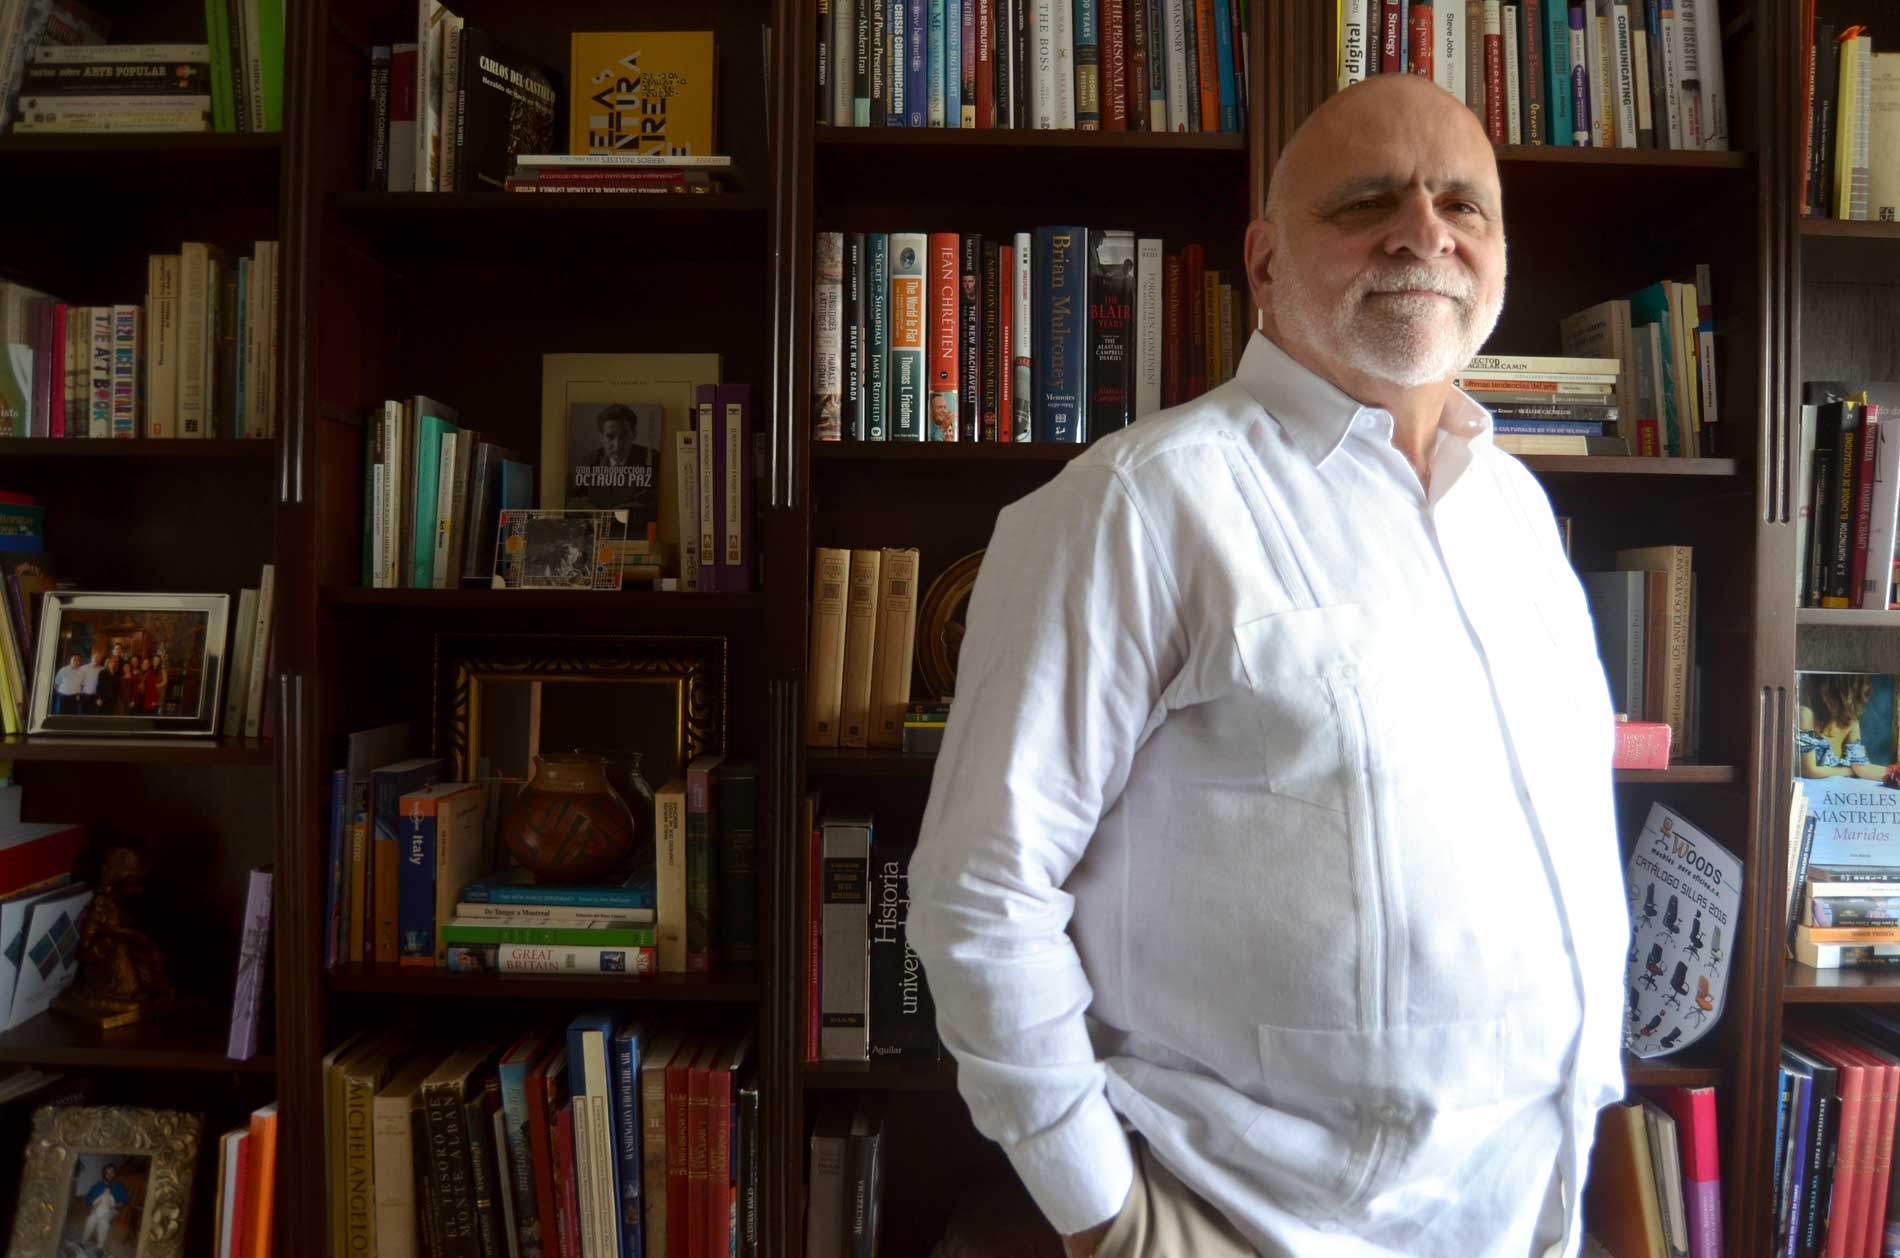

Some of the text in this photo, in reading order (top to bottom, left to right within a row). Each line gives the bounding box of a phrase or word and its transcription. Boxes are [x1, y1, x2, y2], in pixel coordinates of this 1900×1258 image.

[913, 6, 923, 72] new hermetics
[932, 13, 942, 32] ME
[980, 15, 988, 62] REVOLUTION
[1039, 4, 1049, 72] THE BOSS
[1082, 11, 1091, 38] YEARS
[1135, 9, 1143, 45] SECRETO
[1386, 12, 1398, 57] Strategy
[1446, 13, 1454, 37] Steve
[1682, 11, 1697, 72] OF DISASTER
[445, 26, 460, 95] CARLOS FUENTES
[858, 20, 868, 74] Modern Iran
[873, 13, 884, 99] of Power Presentations
[894, 4, 904, 114] CRISIS COMMUNICATION
[1113, 25, 1124, 87] PERSONAL
[1345, 23, 1363, 74] digital
[1446, 38, 1455, 58] Jobs
[1617, 15, 1632, 106] COMMUNICATING
[83, 65, 167, 77] ARTE POPULAR
[480, 55, 509, 81] CARLOS
[510, 69, 524, 88] DEL
[525, 77, 556, 104] CASTILLO
[950, 67, 958, 98] HEART
[999, 64, 1007, 108] MASONRY
[1080, 71, 1088, 106] FRIEDMAN
[1493, 40, 1502, 138] OCCIDENTALISM
[1667, 60, 1675, 106] TRAINING
[379, 84, 388, 115] LONDON
[1114, 94, 1125, 121] MBA
[1530, 104, 1541, 138] OCTAVIO
[375, 117, 387, 170] COMPENDIUM
[601, 156, 665, 165] VERBOS INGLESES
[874, 253, 884, 283] SECRET
[828, 291, 837, 331] LONGITUDES
[905, 281, 919, 343] The World Is Flat
[941, 247, 956, 359] JEAN CHRÉTIEN
[1050, 235, 1072, 390] Brian Mulroney
[1090, 303, 1132, 320] BLAIR
[1104, 295, 1118, 305] THE
[874, 295, 884, 346] SHAMBHALA
[986, 259, 996, 408] NAPOLEON GOLDEN RULES
[1098, 320, 1124, 328] YEARS
[1146, 272, 1158, 388] FORGOTTEN CONTINENT
[92, 313, 112, 422] THE BOOK
[817, 352, 827, 389] FRIEDMAN
[828, 353, 837, 380] THOMAS
[850, 325, 858, 401] BRAVE NEW CANADA
[872, 354, 883, 378] JAMES
[900, 356, 914, 384] Thomas
[968, 305, 977, 403] THE NEW MACHIAVELLI
[872, 381, 882, 422] REDFIELD
[1045, 393, 1075, 401] Memoirs
[1490, 382, 1530, 391] tendencias
[900, 395, 914, 428] Friedman
[1842, 431, 1854, 478] CIVILIZACIONES
[575, 473, 652, 488] OCTAVIO PAZ
[1841, 489, 1852, 512] CHOQUE
[1837, 522, 1849, 562] HUNTINGTON
[1858, 521, 1869, 550] CHAMPY
[1672, 547, 1684, 661] LOS ANTIGUOS MEXICANOS
[1822, 791, 1896, 807] ÁNGELES
[409, 835, 424, 865] Italy
[1833, 827, 1890, 843] Maridos
[1671, 833, 1722, 885] WOODS
[521, 908, 550, 917] Montreal
[875, 861, 899, 944] Historia
[1680, 883, 1708, 909] SILLAS
[506, 960, 559, 971] BRITAIN
[511, 949, 554, 960] GREAT
[872, 1044, 903, 1055] Aguilar
[620, 1052, 635, 1161] WASHINGTON FROM THE AIR
[349, 1084, 369, 1251] MICHELANGELO
[430, 1097, 457, 1238] EL TESORO DE
[443, 1096, 471, 1238] MONTE ALBAN
[1806, 1097, 1827, 1248] RENAISSANCE VAN EYCK TITIAN
